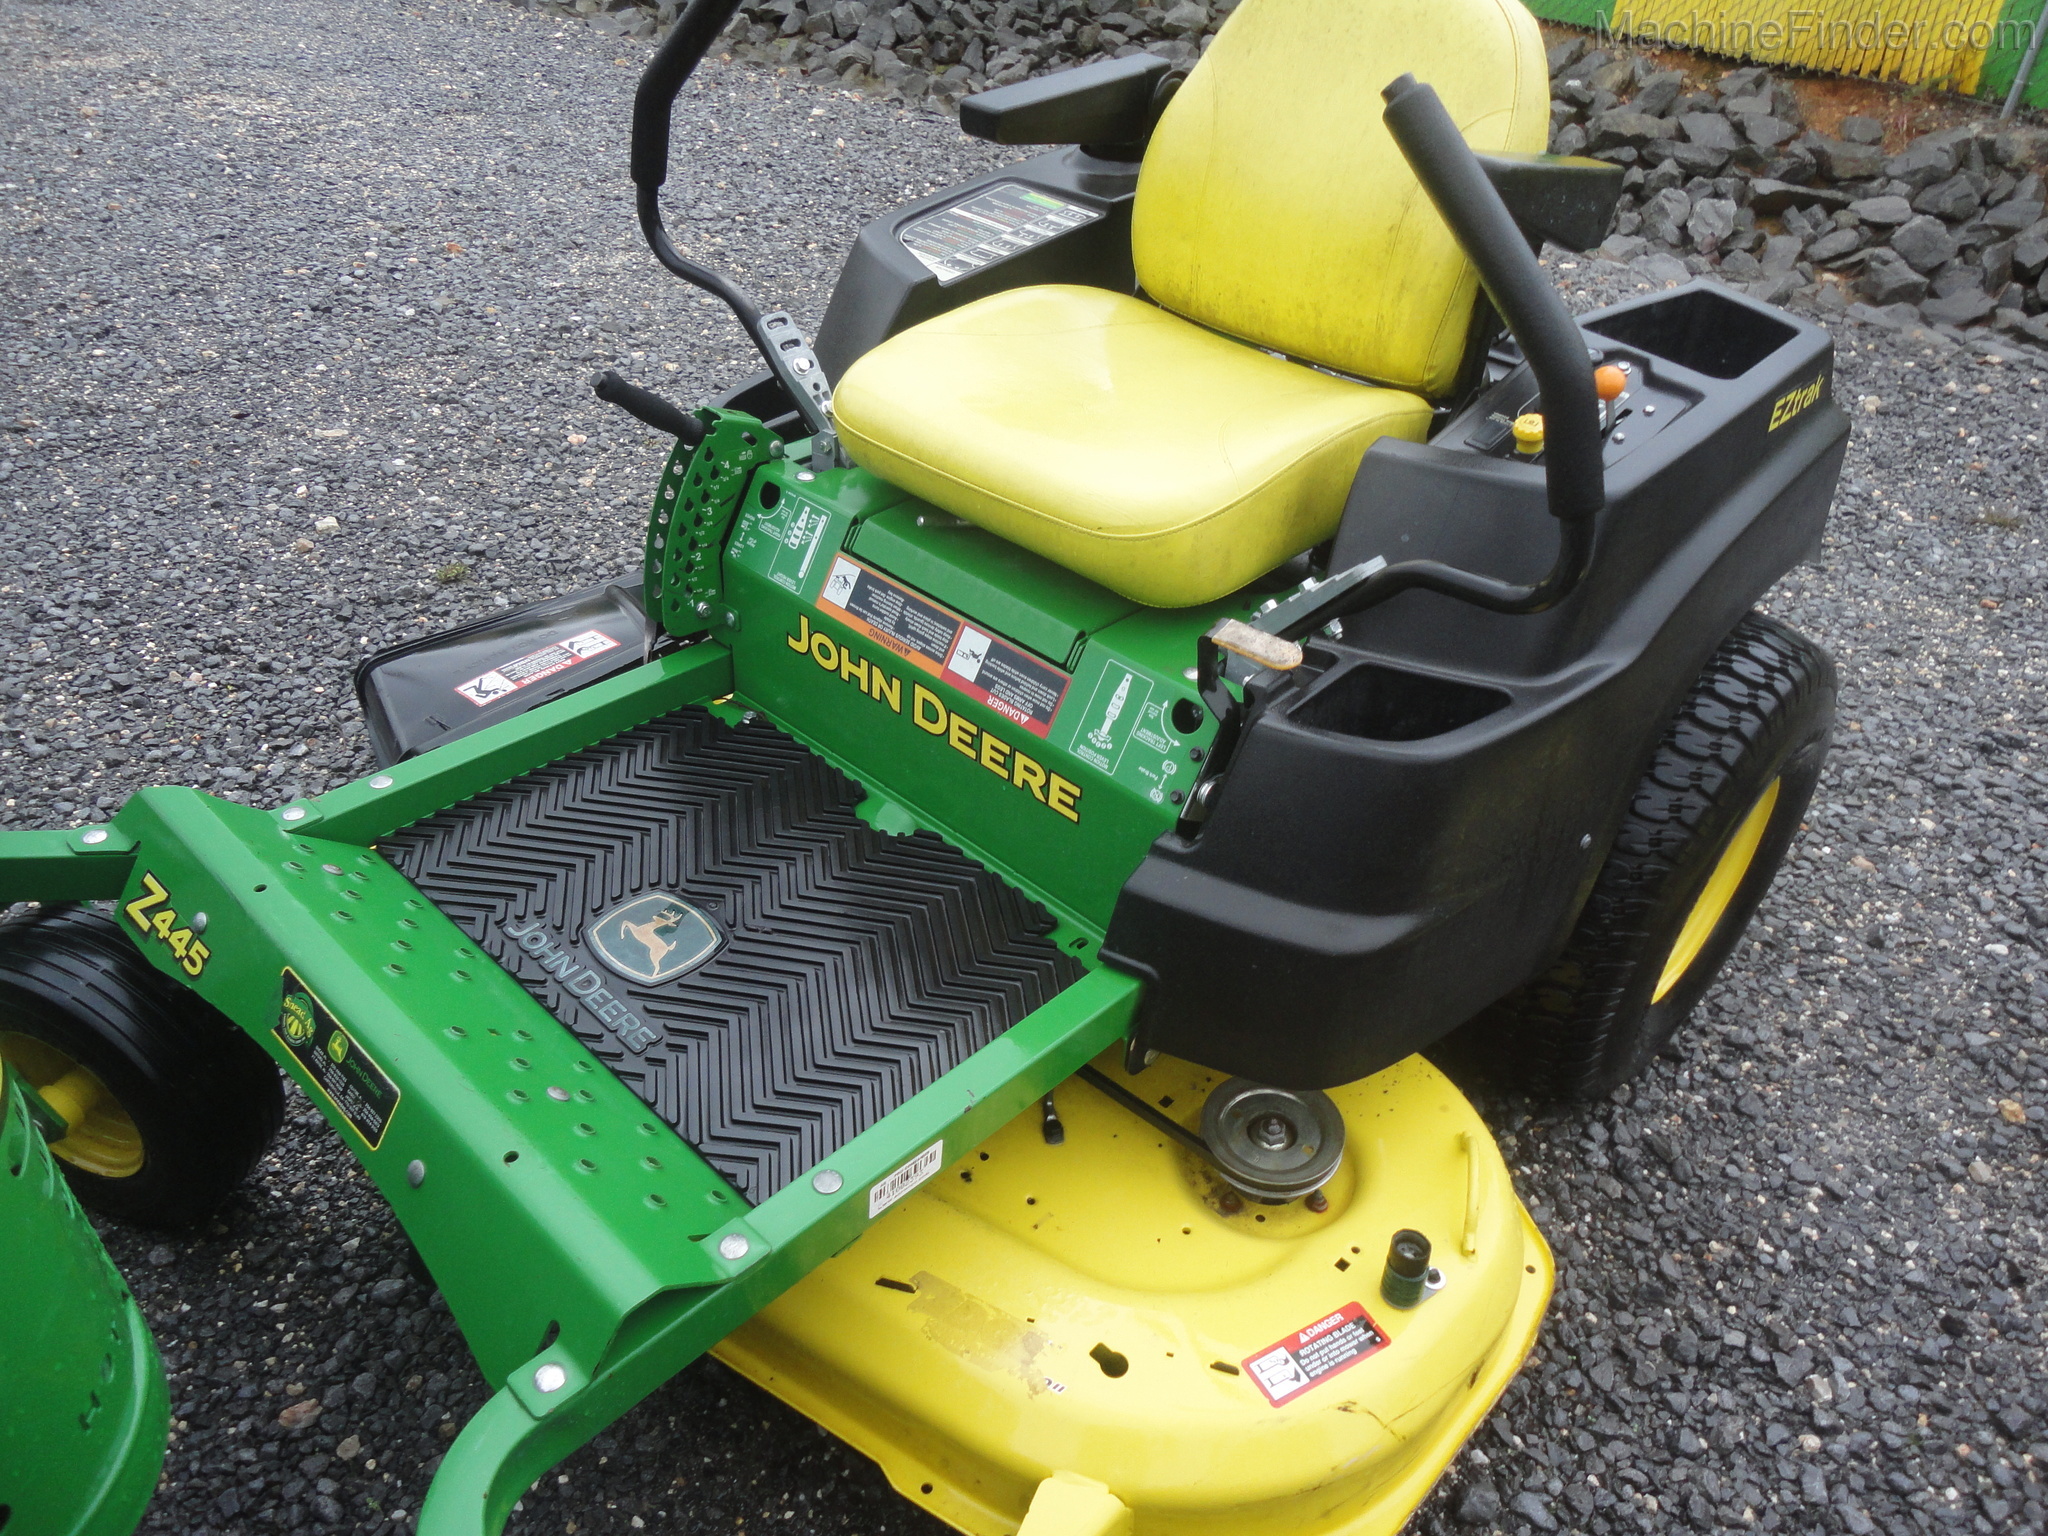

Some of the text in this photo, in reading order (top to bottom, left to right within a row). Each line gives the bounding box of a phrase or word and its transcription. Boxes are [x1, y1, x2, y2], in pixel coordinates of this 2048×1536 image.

[1767, 373, 1825, 434] EZtrak
[707, 507, 712, 515] 3
[866, 616, 878, 626] DEATH
[882, 626, 895, 636] INJURY
[867, 627, 904, 653] WARNING
[894, 632, 910, 645] SERIOUS
[909, 641, 921, 651] AVOID
[520, 663, 565, 684] DANGER
[981, 669, 992, 678] around
[997, 678, 1008, 686] others
[986, 694, 1020, 720] DANGER
[989, 687, 1033, 715] ROTATING BLADES CUT
[994, 683, 1033, 709] OFF ARMS AND LEGS
[787, 613, 1082, 824] JOHN DEERE
[1135, 730, 1166, 750] LEFT TRACKING
[1140, 726, 1166, 744] ADJUSTMENT
[1075, 747, 1108, 769] MOTION CONTROL
[1078, 743, 1109, 764] LEVER POSITION
[1137, 765, 1158, 781] Park Brake
[125, 873, 211, 977] Z445
[508, 922, 656, 1049] JOHN DEERE
[282, 997, 306, 1019] Snead
[304, 1015, 315, 1038] Ag
[346, 1057, 363, 1076] JOHN
[362, 1073, 382, 1098] DEERE
[1304, 1312, 1345, 1337] DANGER
[1297, 1321, 1357, 1356] ROTATING BLADE
[1299, 1327, 1365, 1366] Do not put hands or feet
[1303, 1359, 1322, 1372] under
[1327, 1349, 1340, 1358] into
[1338, 1338, 1359, 1352] mower
[1357, 1330, 1374, 1341] when
[1308, 1363, 1330, 1378] engine
[1333, 1347, 1358, 1364] running
